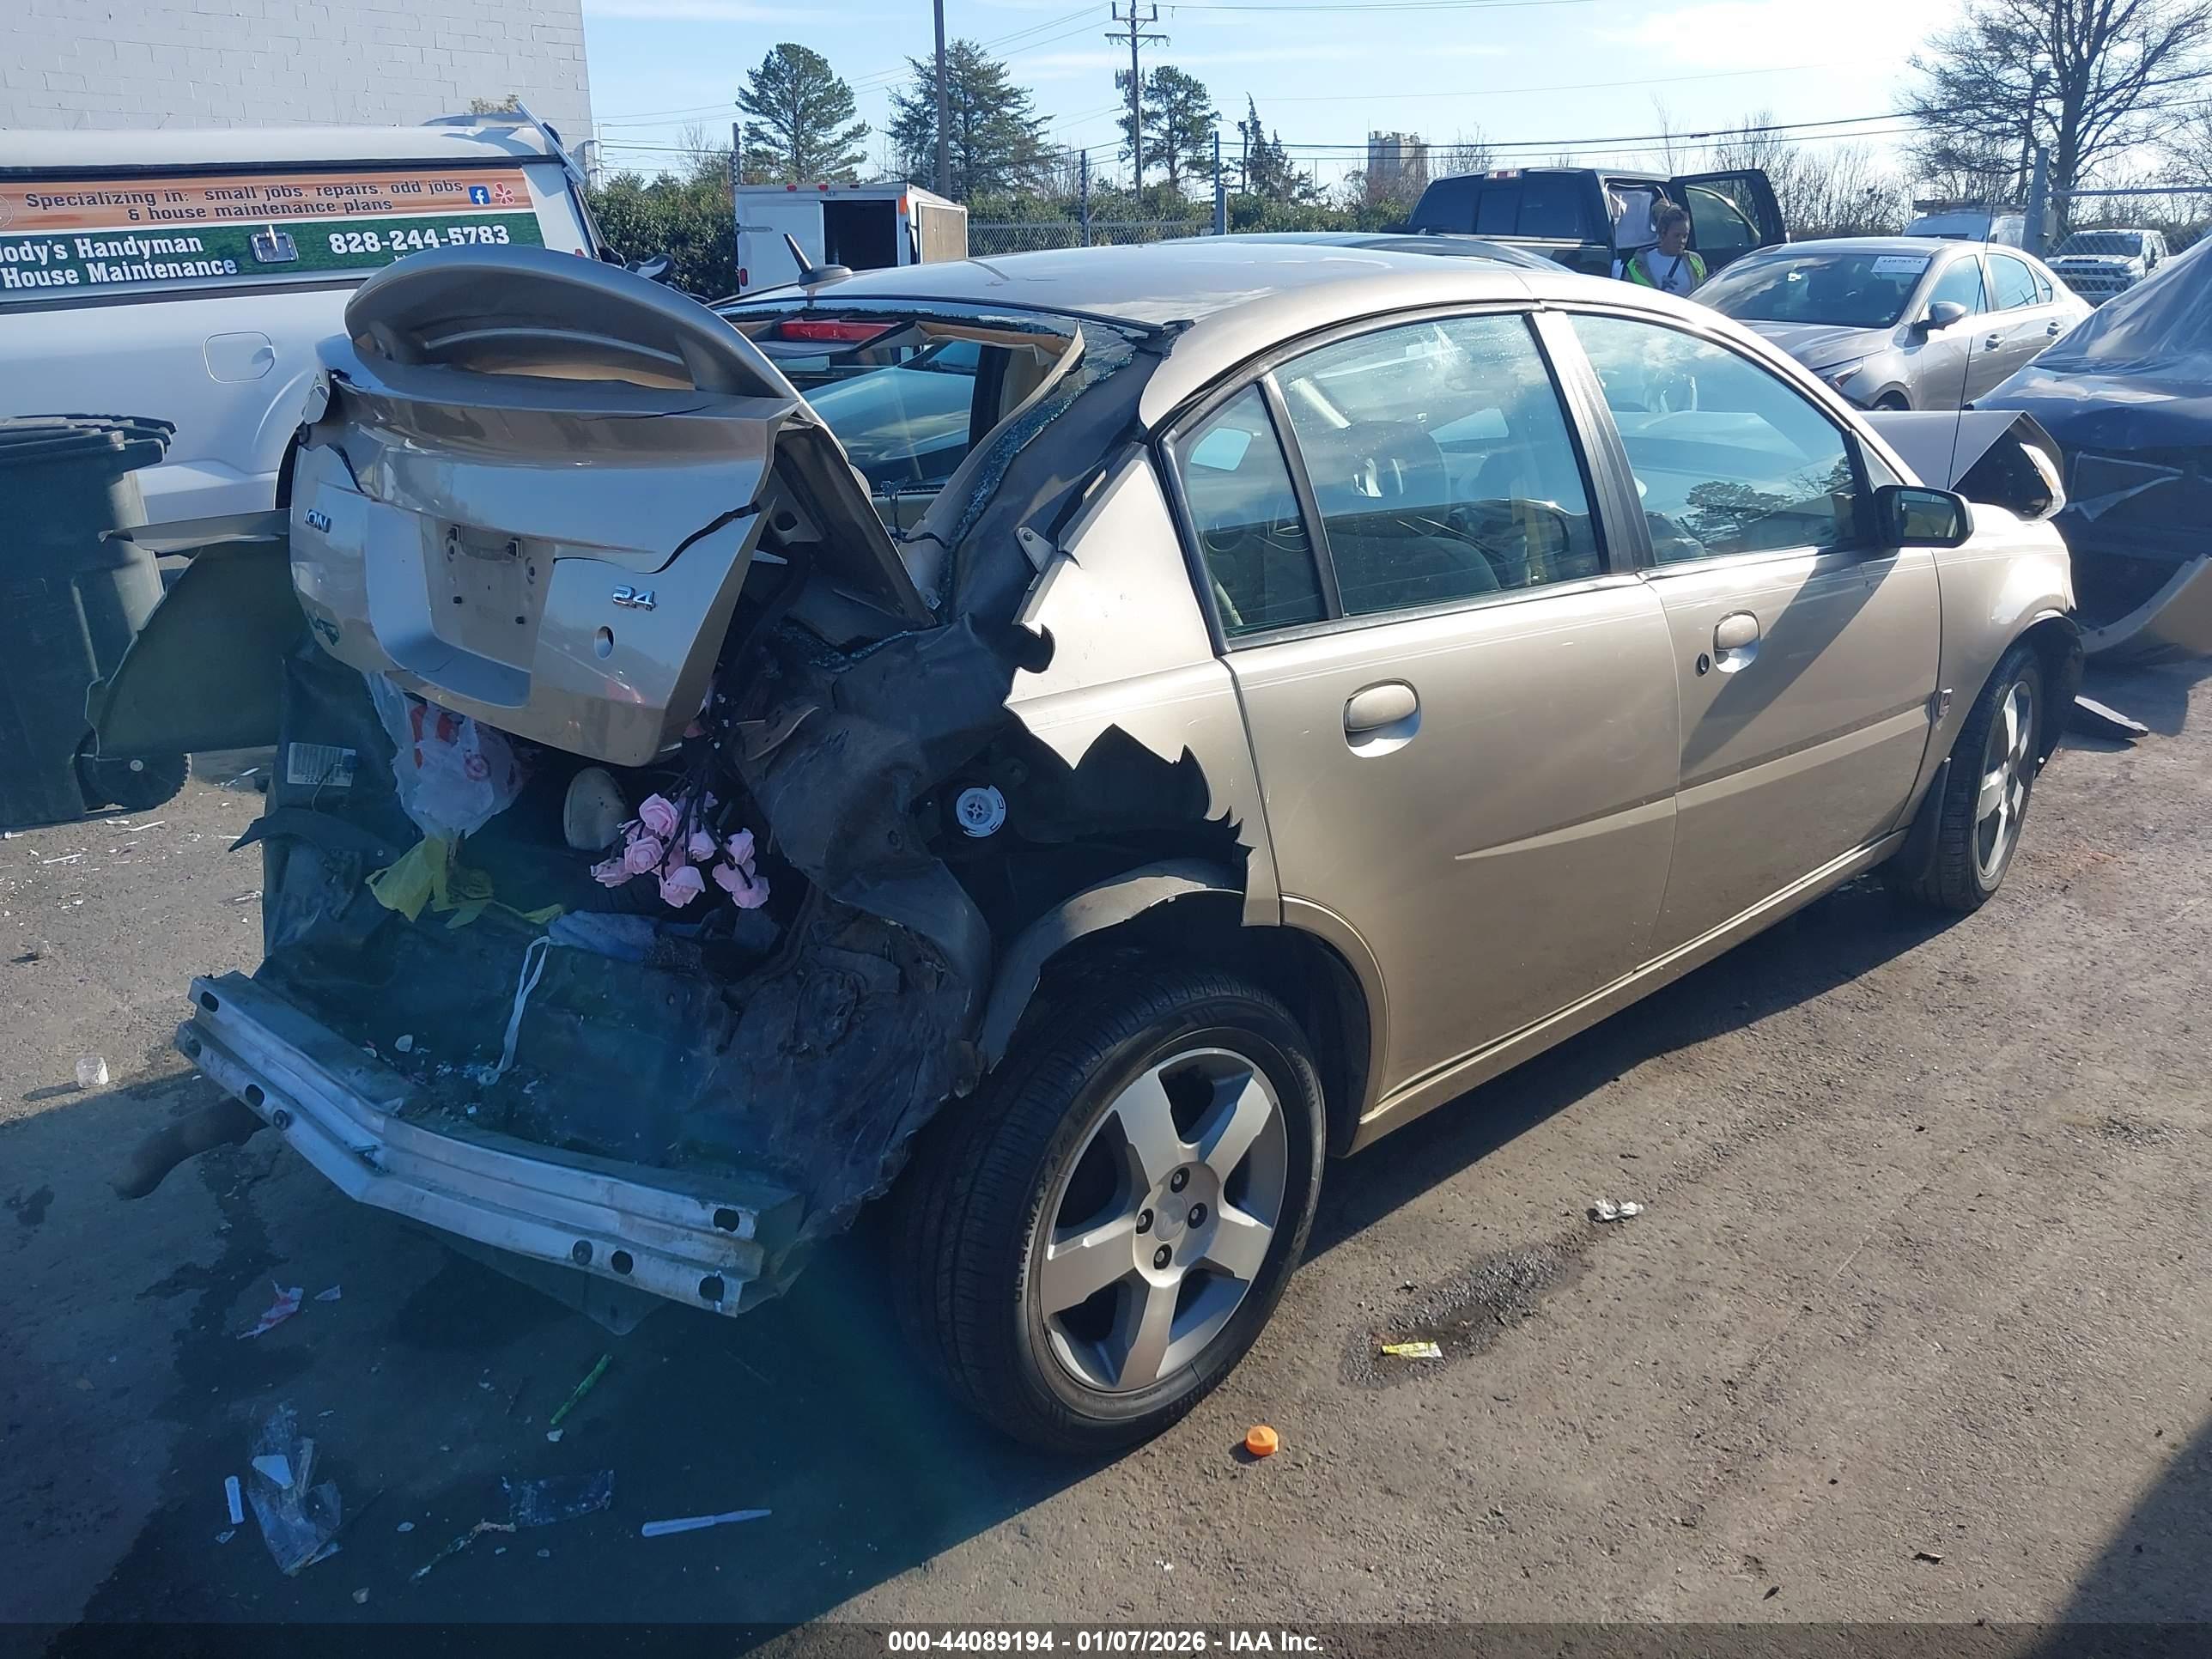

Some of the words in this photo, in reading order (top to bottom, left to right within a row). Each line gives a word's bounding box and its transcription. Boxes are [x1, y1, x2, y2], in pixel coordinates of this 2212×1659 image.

[25, 191, 156, 210] Specializing
[163, 189, 190, 203] in:
[204, 185, 257, 201] small
[391, 180, 422, 194] odd
[428, 179, 464, 195] jobs
[128, 207, 140, 221] &
[149, 205, 207, 221] house
[215, 201, 337, 217] maintenance
[343, 198, 393, 214] plans
[74, 236, 204, 259] Handyman
[328, 225, 510, 255] 828-244-5783
[1, 266, 80, 289] House
[85, 258, 238, 283] Maintenance
